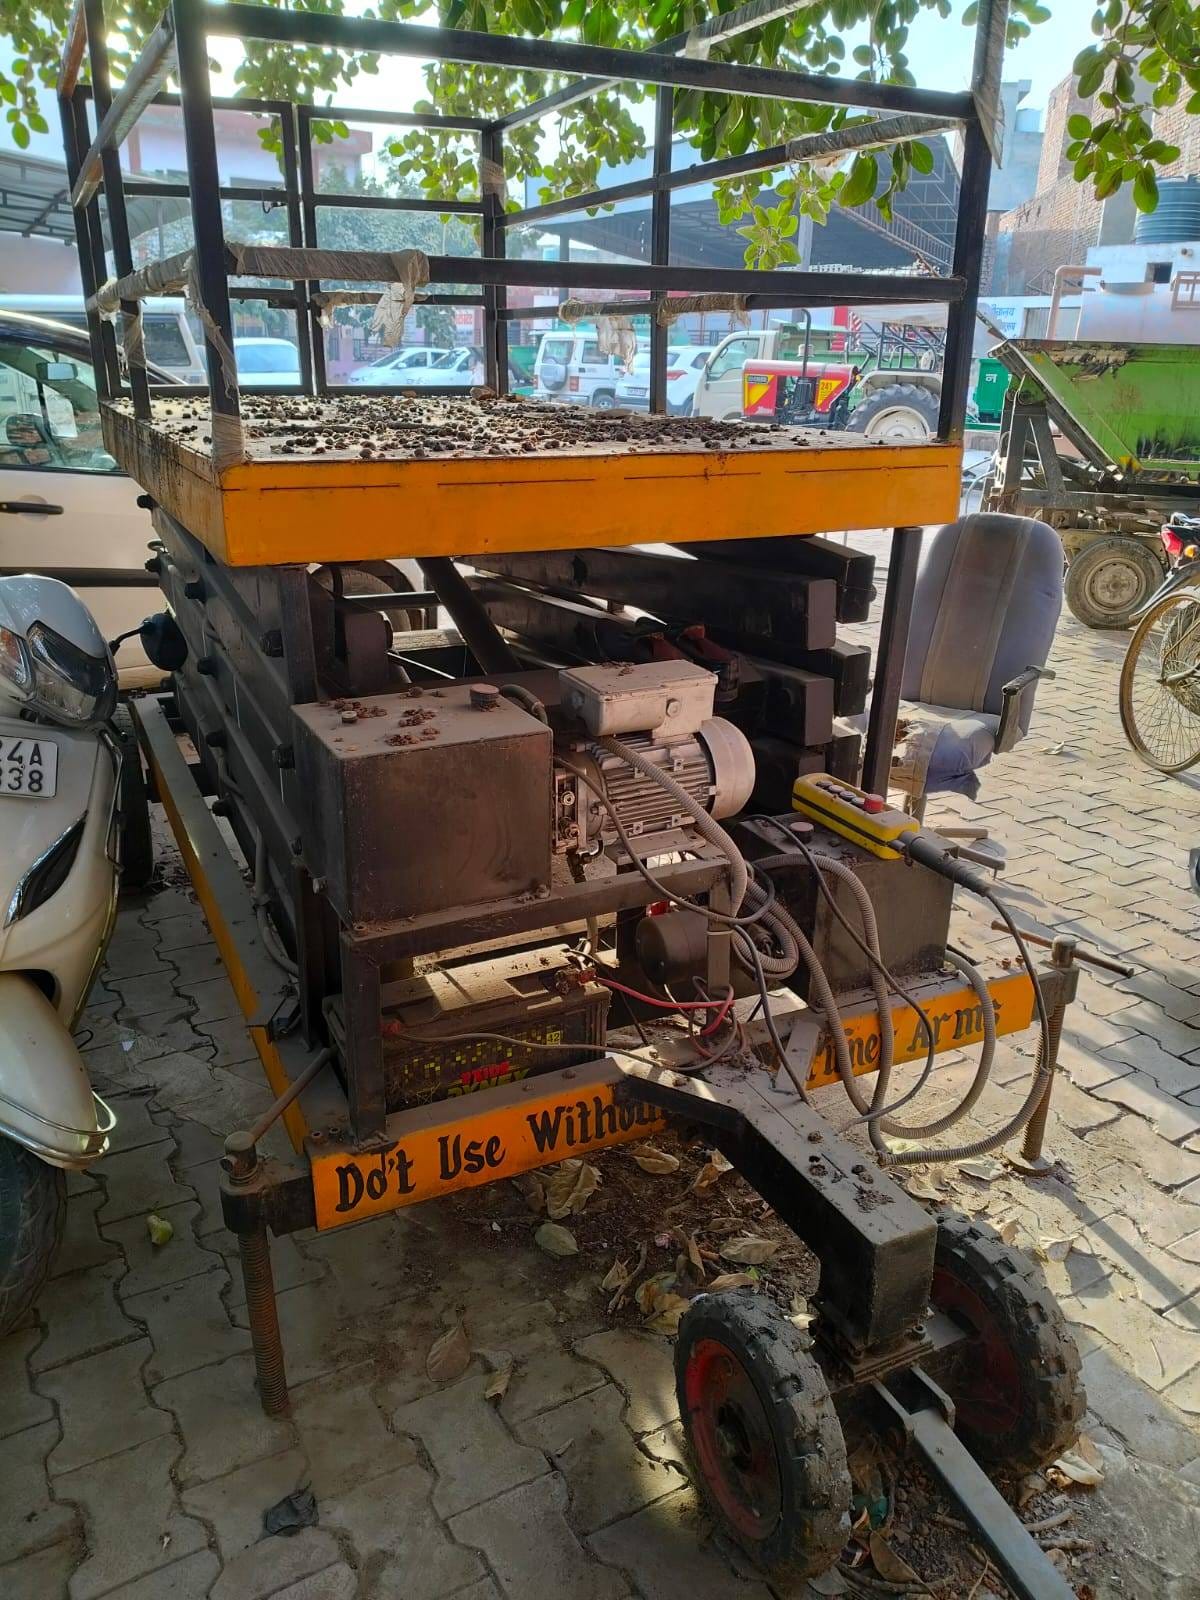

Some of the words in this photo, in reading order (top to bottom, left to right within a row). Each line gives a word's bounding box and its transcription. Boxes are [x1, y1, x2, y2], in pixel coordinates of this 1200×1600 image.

[0, 741, 42, 766] 4A
[0, 767, 43, 793] 38
[438, 1134, 505, 1180] Use
